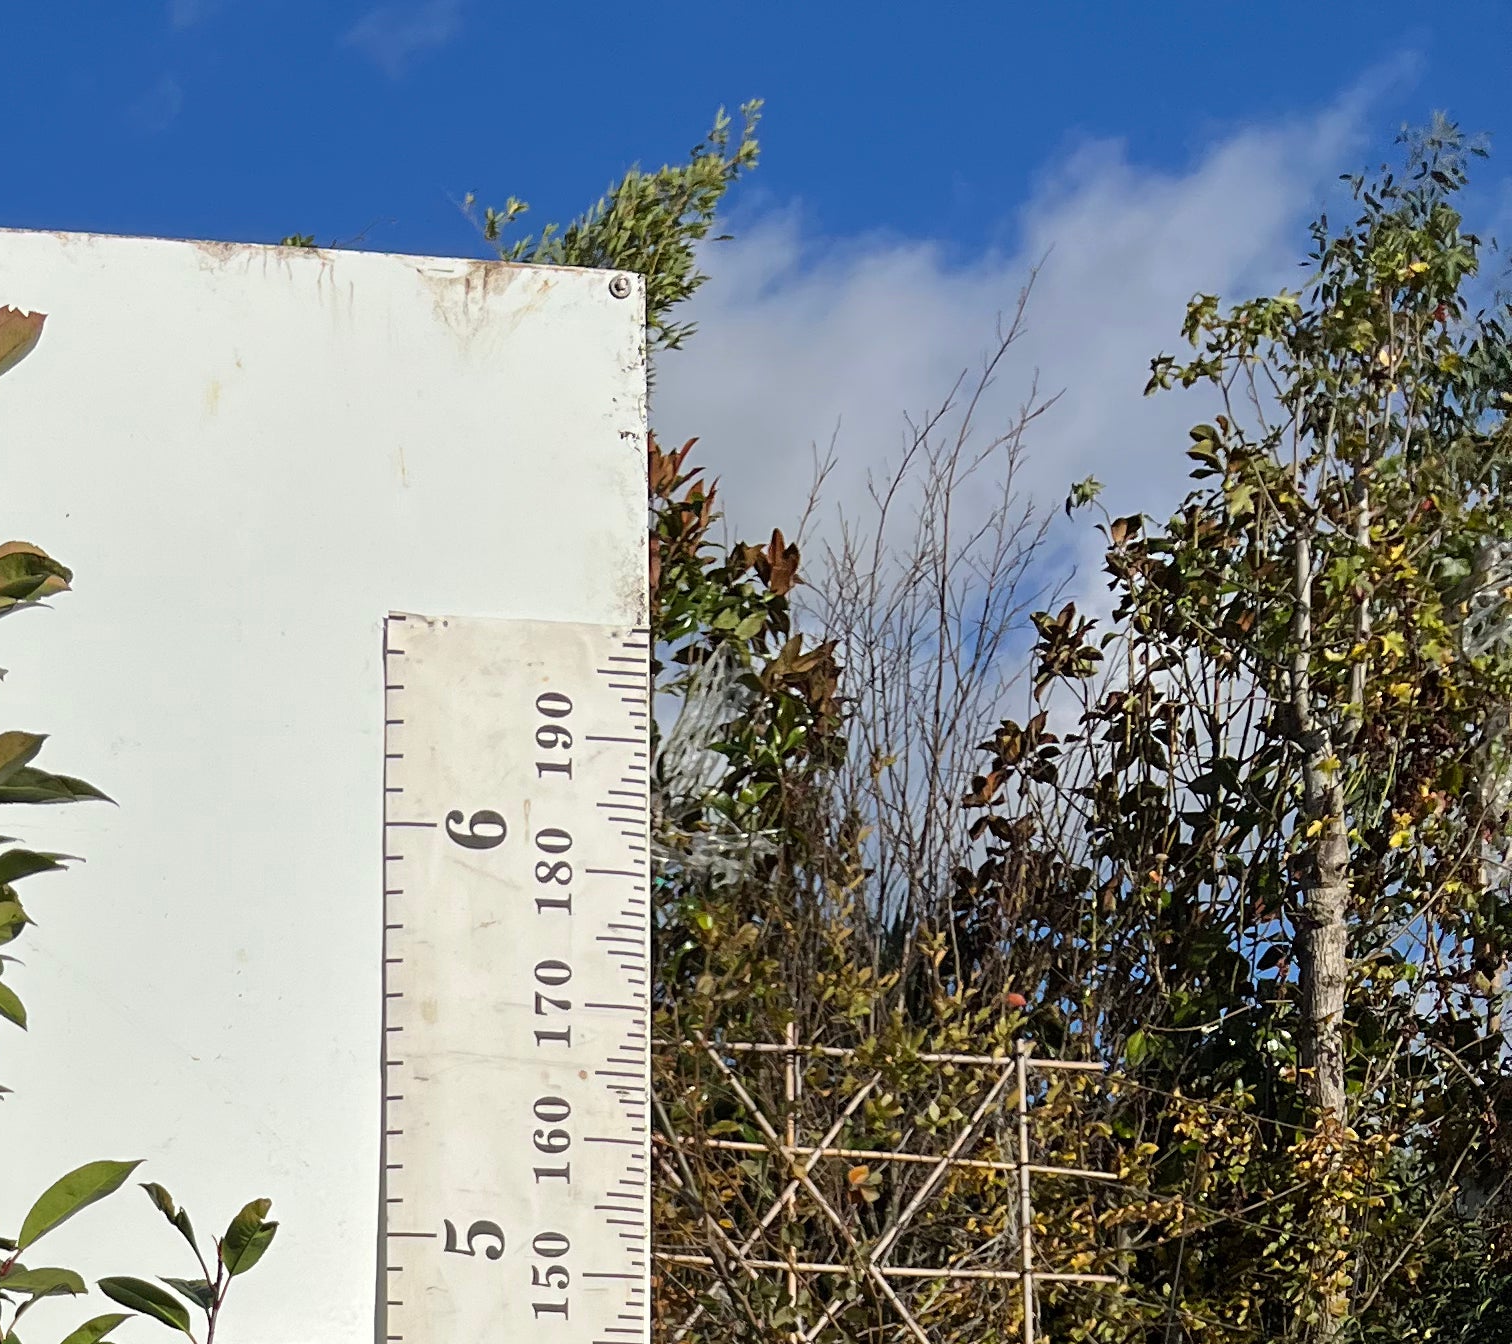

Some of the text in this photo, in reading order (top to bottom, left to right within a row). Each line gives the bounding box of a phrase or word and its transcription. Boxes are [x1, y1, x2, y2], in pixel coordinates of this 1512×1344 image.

[535, 692, 573, 780] 190
[445, 810, 507, 850] 6
[535, 828, 572, 916] 180
[534, 960, 572, 1048] 170
[533, 1096, 571, 1184] 160
[443, 1218, 506, 1260] 5
[532, 1232, 570, 1321] 150
